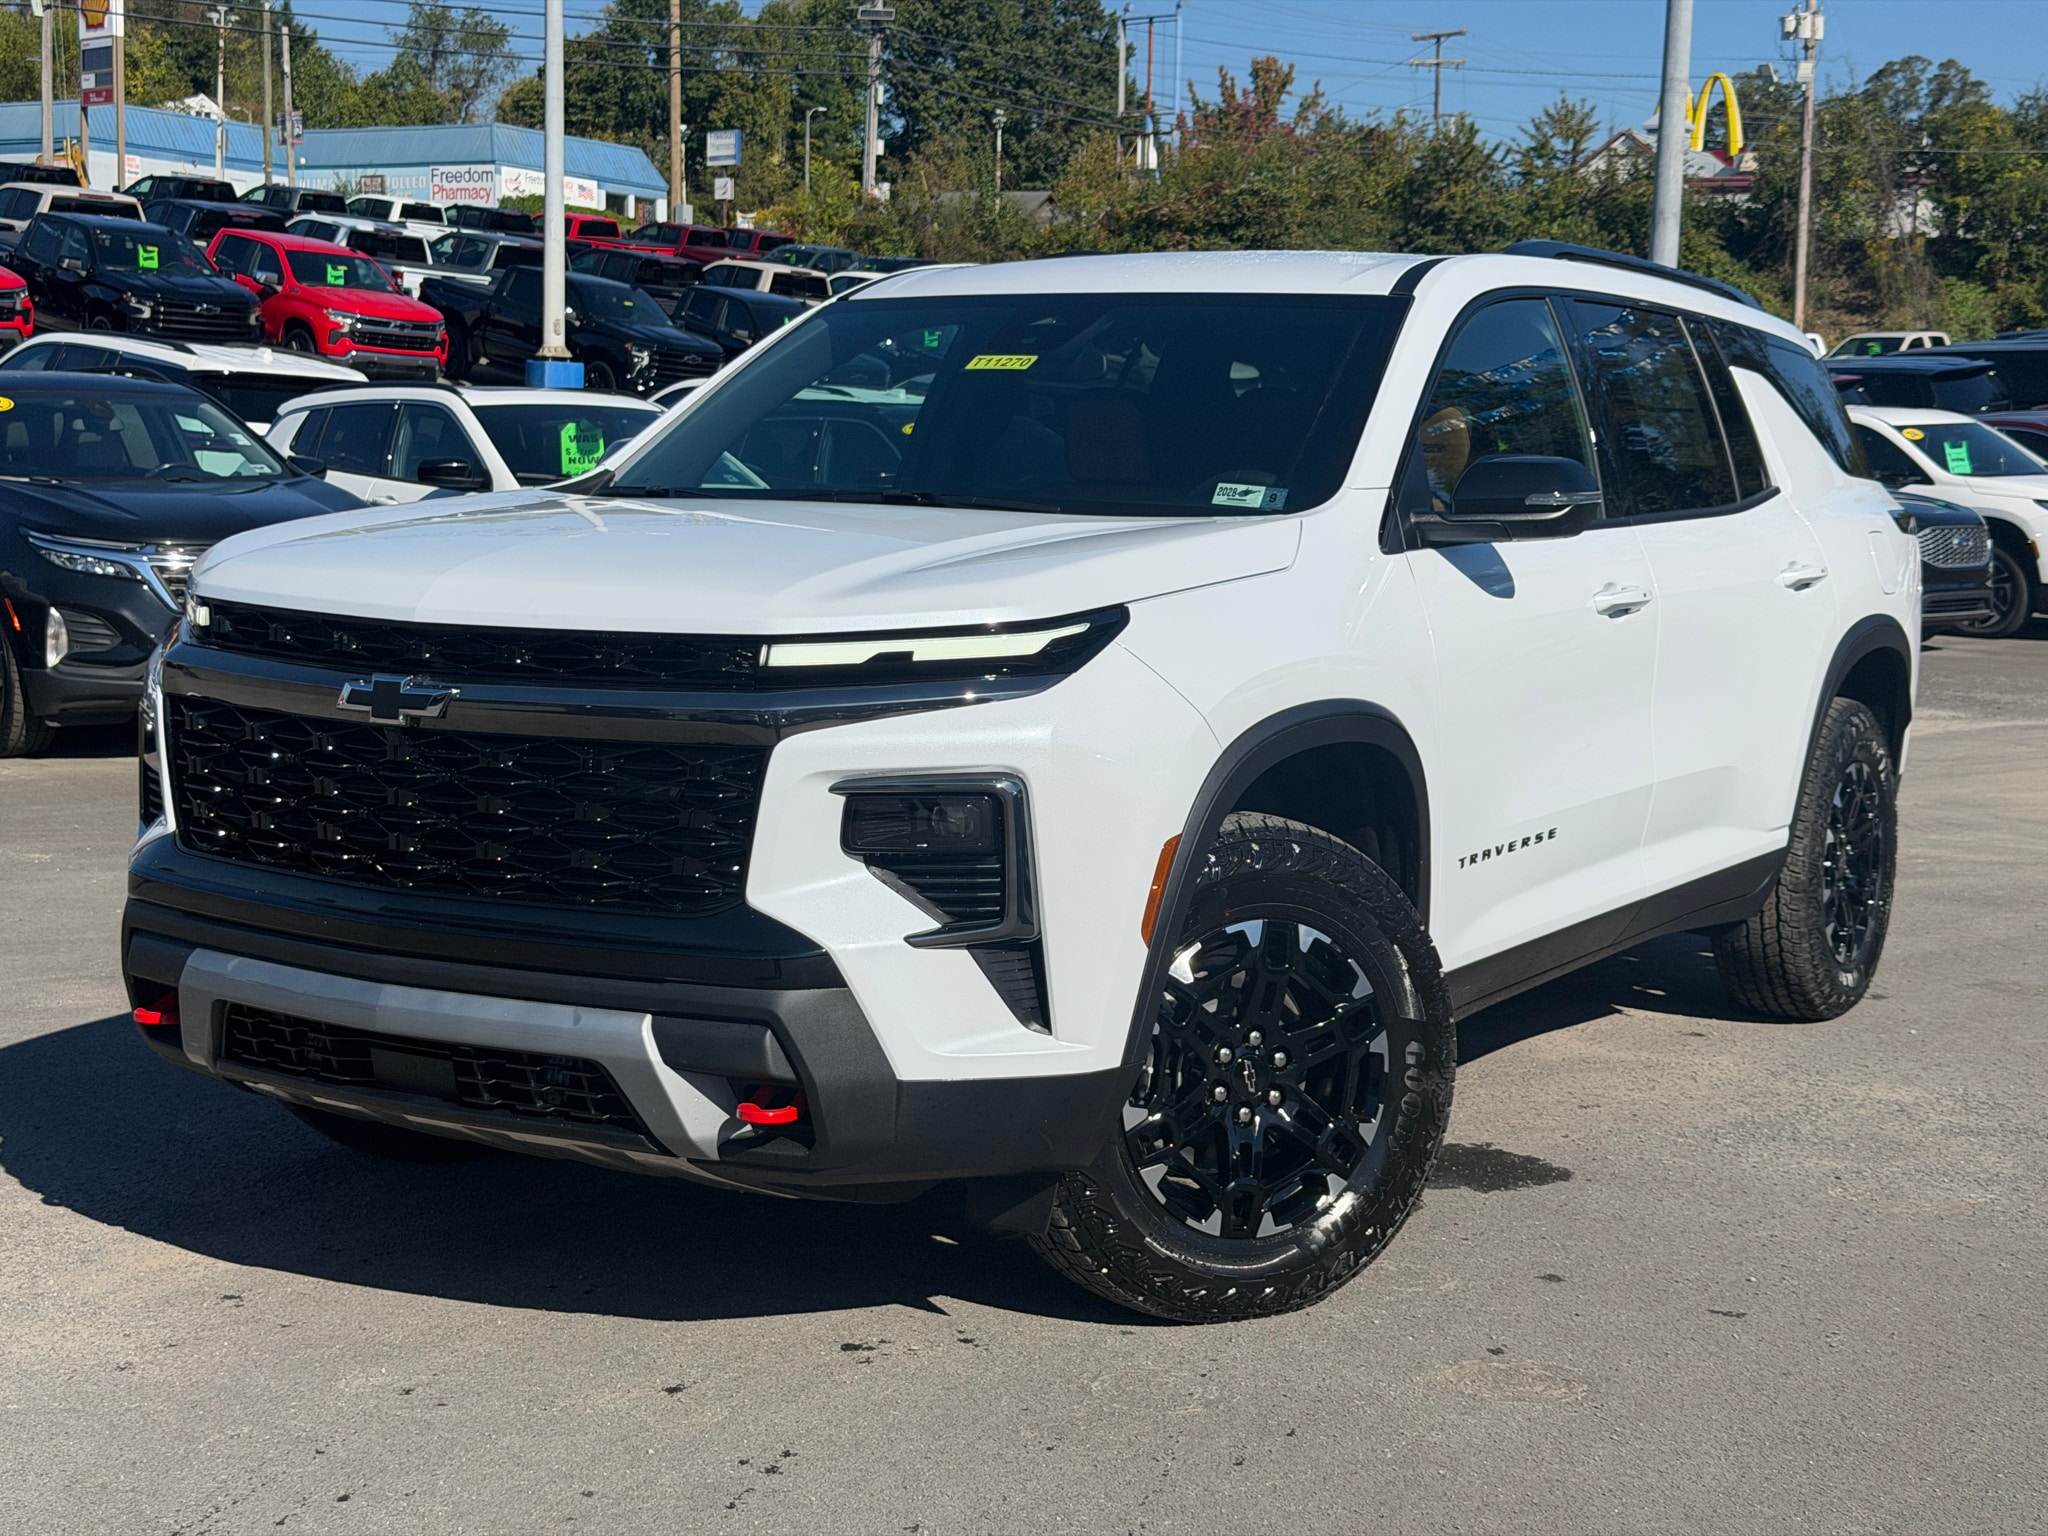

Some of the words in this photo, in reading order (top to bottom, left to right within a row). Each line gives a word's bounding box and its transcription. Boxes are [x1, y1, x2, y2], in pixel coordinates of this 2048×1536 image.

[431, 167, 494, 184] Freedom
[432, 184, 492, 204] Pharmacy
[973, 357, 1032, 367] T11270
[568, 434, 599, 442] WAS
[568, 457, 599, 465] NOW
[1216, 486, 1238, 497] 2028
[1269, 494, 1277, 503] 9
[1458, 827, 1558, 869] TRAVERSE
